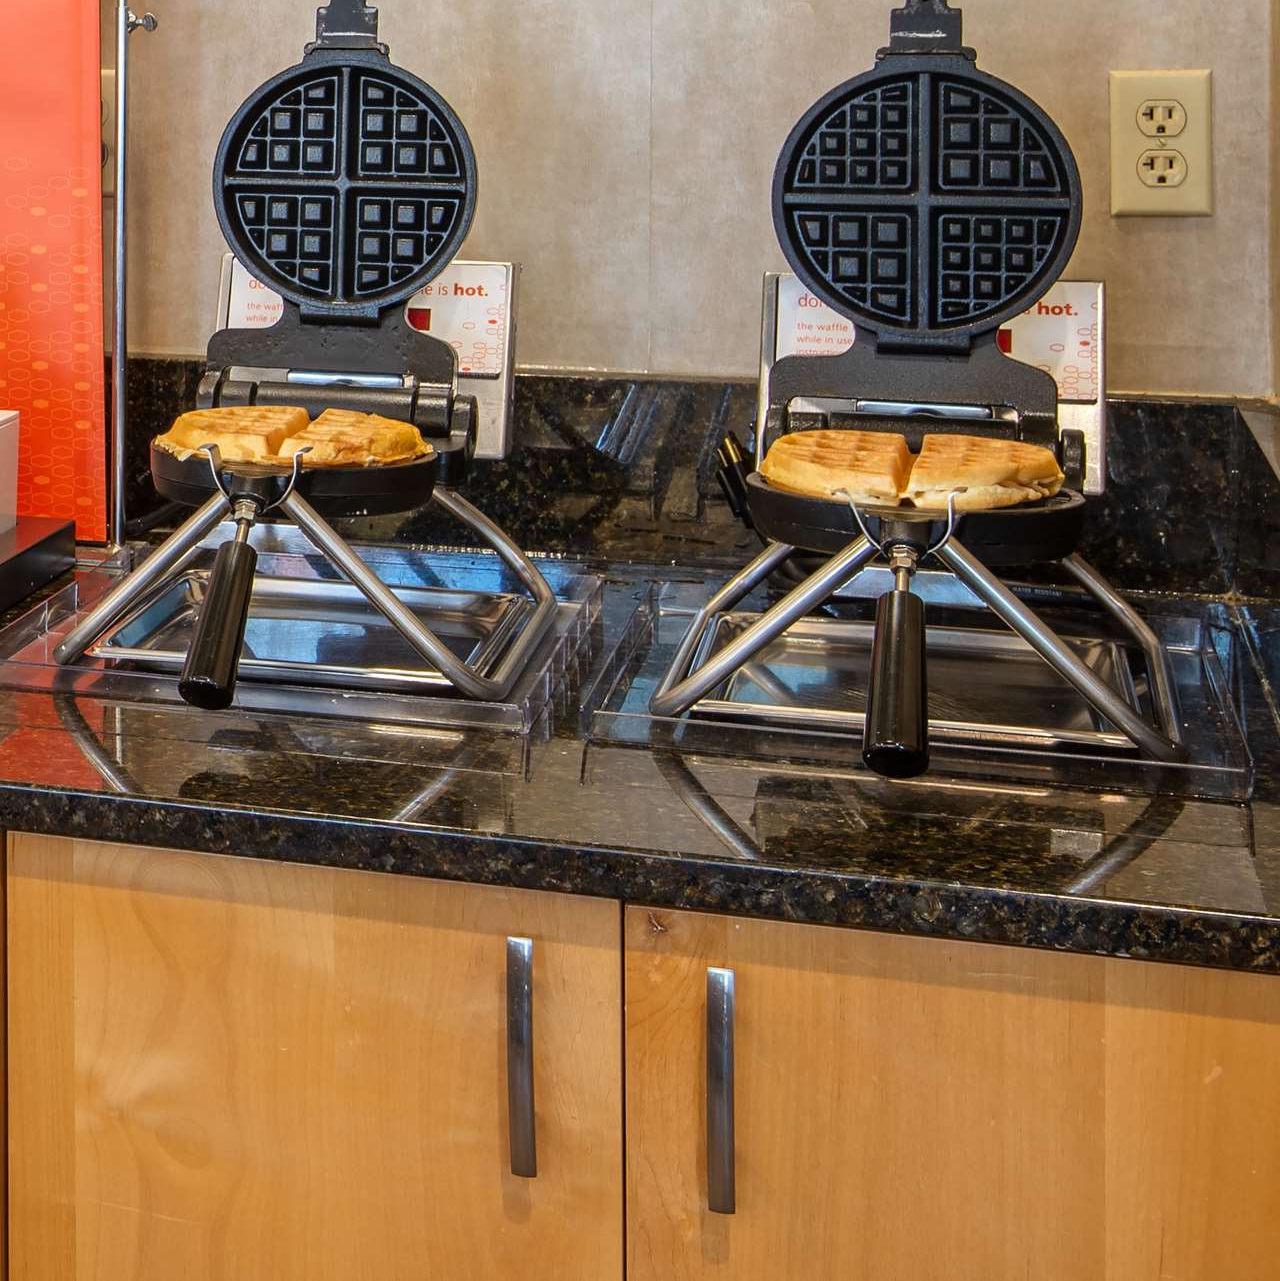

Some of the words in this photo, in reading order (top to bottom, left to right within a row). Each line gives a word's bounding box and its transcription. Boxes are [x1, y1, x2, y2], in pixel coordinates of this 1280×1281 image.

[438, 283, 448, 295] is
[454, 283, 488, 296] hot.
[248, 302, 261, 310] the
[1037, 301, 1078, 316] hot.
[816, 323, 848, 331] waffle
